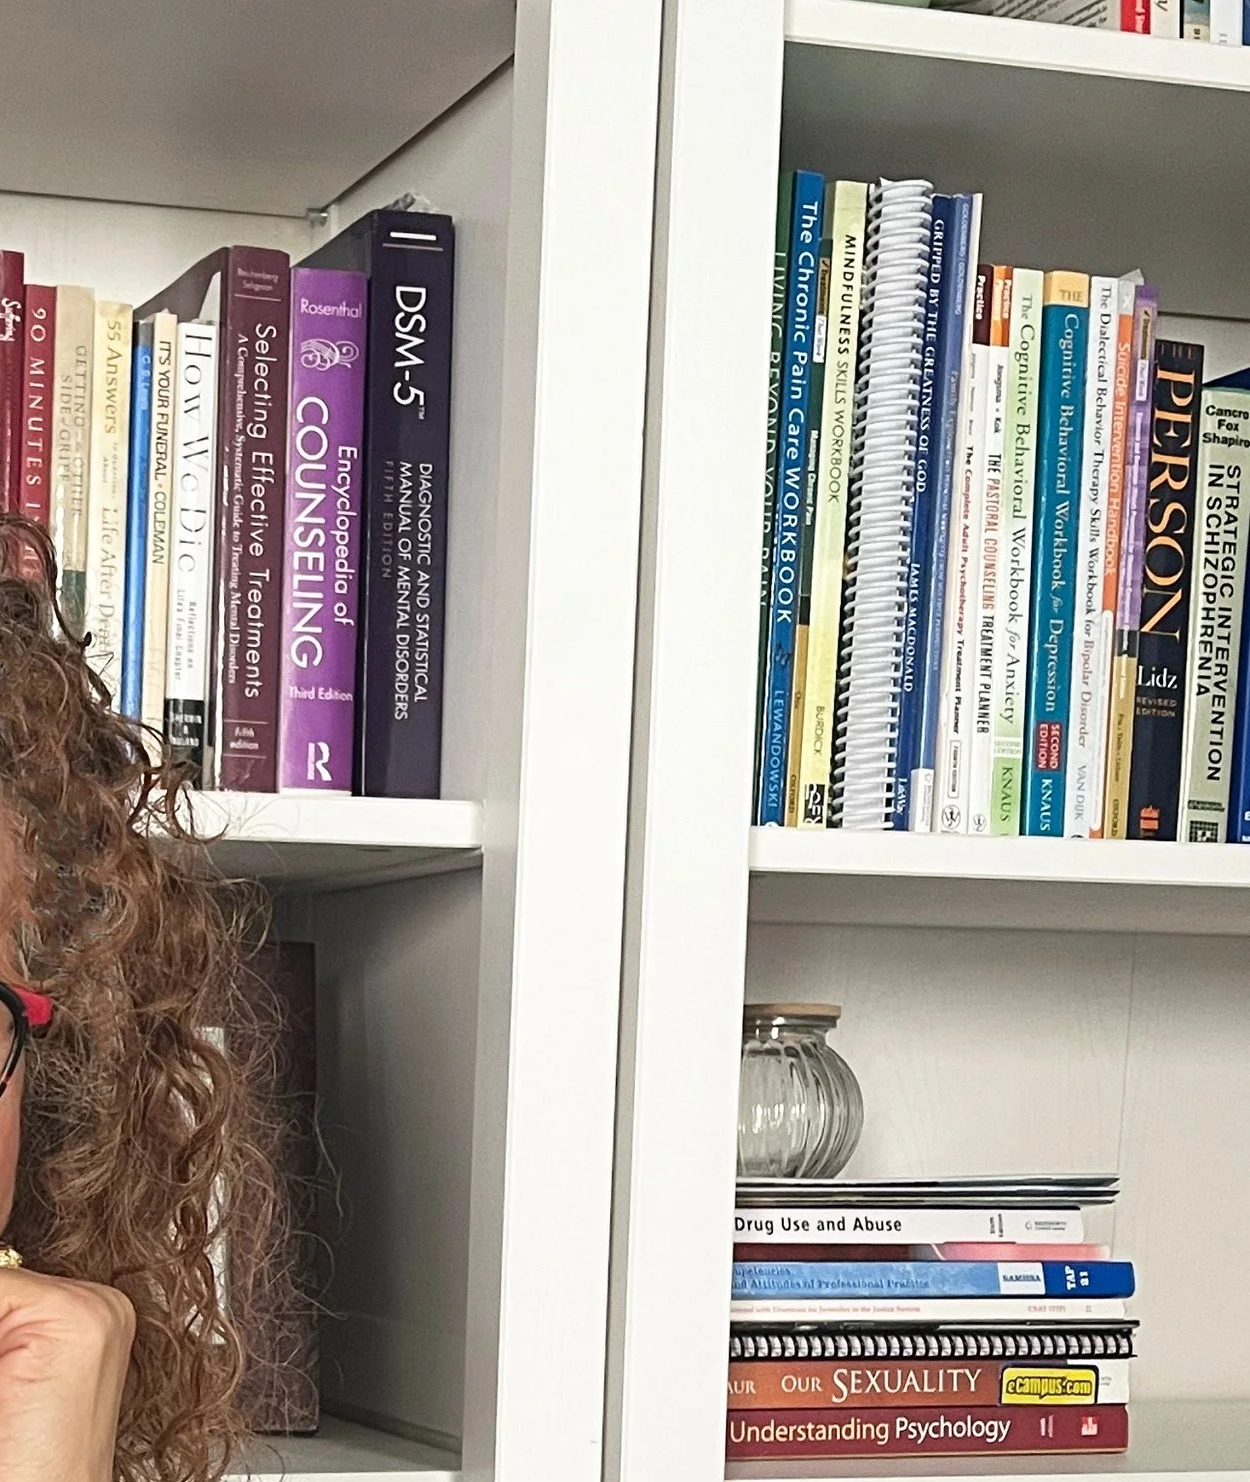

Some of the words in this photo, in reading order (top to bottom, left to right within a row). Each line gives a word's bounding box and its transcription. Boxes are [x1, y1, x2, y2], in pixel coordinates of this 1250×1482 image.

[800, 201, 820, 244] The
[930, 219, 945, 284] GRIPPED
[29, 307, 48, 342] 90
[299, 298, 363, 319] Rosenthal
[792, 251, 815, 343] Chronic
[837, 234, 857, 355] MINDFULNESS
[925, 311, 938, 341] THE
[928, 289, 940, 306] BY
[1020, 295, 1033, 321] The
[393, 285, 427, 406] DSM-5
[789, 350, 807, 400] Pain
[1015, 324, 1036, 417] Cognitive
[1058, 313, 1080, 399] Cognitive
[246, 323, 277, 439] Selecting
[834, 360, 849, 404] SKILLS
[918, 346, 936, 431] GREATNESS
[1205, 405, 1250, 420] Cancro
[26, 357, 45, 486] MINUTES
[785, 407, 803, 460] Care
[918, 435, 930, 453] OF
[1054, 404, 1076, 495] Behavioral
[1217, 419, 1240, 432] Fox
[827, 409, 845, 503] WORKBOOK
[916, 459, 928, 493] GOD
[987, 453, 1002, 474] THE
[1011, 423, 1031, 520] Behavioral
[1207, 465, 1225, 488] IN
[152, 490, 167, 566] COLEMAN
[233, 488, 244, 528] Guide
[248, 451, 275, 557] Effective
[331, 445, 358, 594] Encyclopedia
[397, 461, 412, 537] MANUAL
[416, 462, 433, 566] DIAGNOSTIC
[984, 478, 1001, 534] PASTORAL
[1139, 364, 1196, 645] PERSON
[232, 530, 242, 543] to
[290, 396, 329, 669] COUNSELING
[397, 538, 412, 561] OF
[776, 466, 801, 623] WORKBOOK
[1050, 501, 1070, 590] Workbook
[1219, 465, 1242, 599] STRATEGIC
[395, 566, 411, 630] MENTAL
[416, 571, 431, 609] AND
[907, 563, 922, 601] JAMES
[982, 537, 1001, 610] COUNSELING
[1007, 526, 1027, 623] Workbook
[1050, 594, 1063, 614] for
[1195, 495, 1222, 697] SCHIZOPHRENIA
[244, 569, 270, 699] Treatments
[334, 602, 354, 626] of
[1004, 628, 1021, 650] for
[394, 633, 410, 721] DISORDERS
[414, 613, 430, 703] STATISTICAL
[903, 606, 919, 693] MACDONALD
[978, 615, 996, 679] TREATMENT
[1042, 618, 1064, 712] Depression
[1136, 664, 1178, 690] Lidz
[289, 686, 316, 700] Third
[317, 687, 353, 702] Edition
[976, 682, 994, 735] PLANNER
[1000, 652, 1019, 724] Anxiety
[1206, 606, 1233, 782] INTERVENTION
[767, 689, 786, 807] LEWANDOWSKI
[1037, 723, 1049, 769] EDITION
[1049, 723, 1061, 769] SECOND
[1000, 766, 1014, 822] KNAUS
[1039, 778, 1054, 832] KNAUS
[734, 1216, 774, 1236] Drug
[781, 1216, 810, 1232] Use
[816, 1216, 846, 1232] and
[852, 1216, 902, 1232] Abuse
[729, 1417, 889, 1445] Understanding
[894, 1415, 1011, 1445] Psychology
